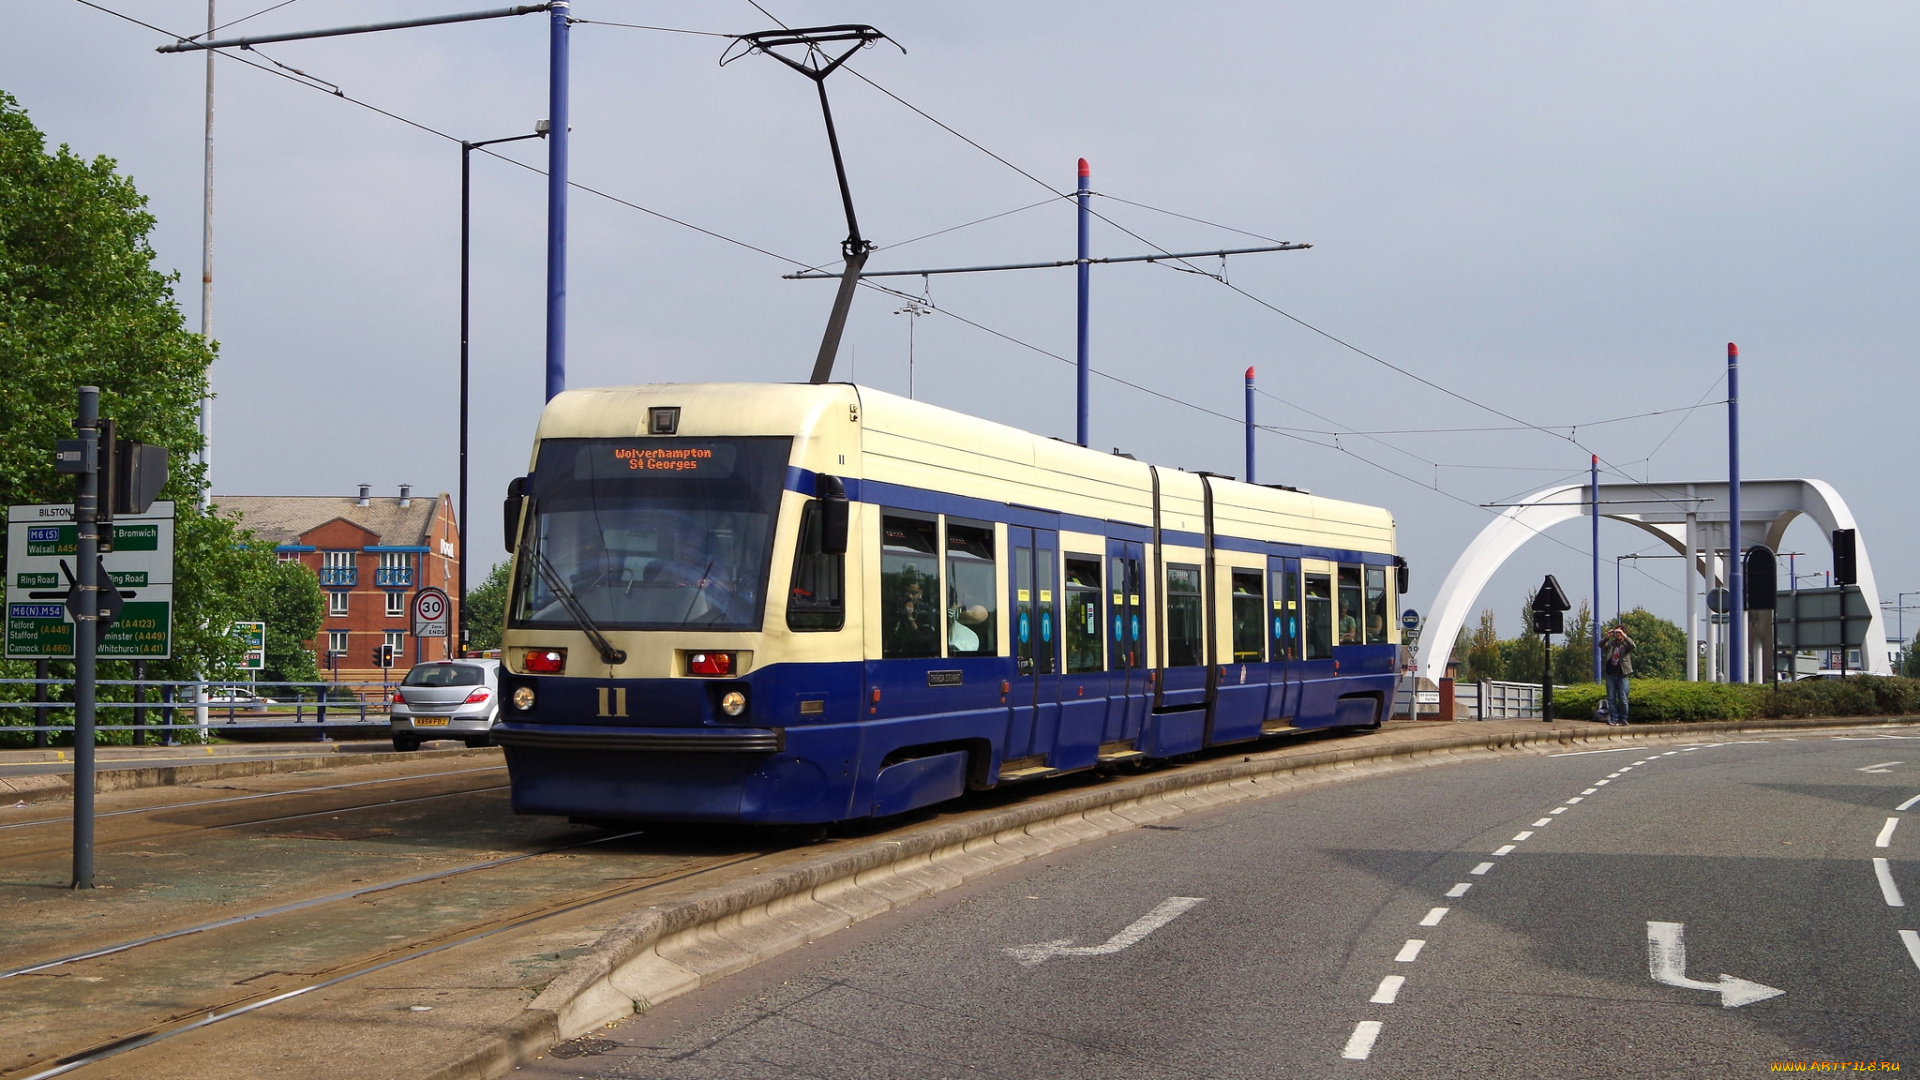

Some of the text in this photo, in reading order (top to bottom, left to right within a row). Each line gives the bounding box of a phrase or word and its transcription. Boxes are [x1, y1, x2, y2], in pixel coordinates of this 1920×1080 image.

[615, 448, 712, 459] Wolverhampton
[629, 459, 697, 471] St Georges
[39, 508, 72, 517] BILSTON
[30, 529, 58, 540] M6 (S)
[118, 528, 157, 538] Bromwich
[28, 544, 56, 554] Walsall
[20, 575, 55, 586] Ring Road
[125, 574, 144, 583] Road
[422, 601, 441, 613] 30
[10, 620, 35, 629] Telford
[10, 630, 39, 639] Stafford
[9, 643, 40, 653] Cannock
[98, 644, 139, 653] Whitchurch
[595, 686, 630, 717] 11
